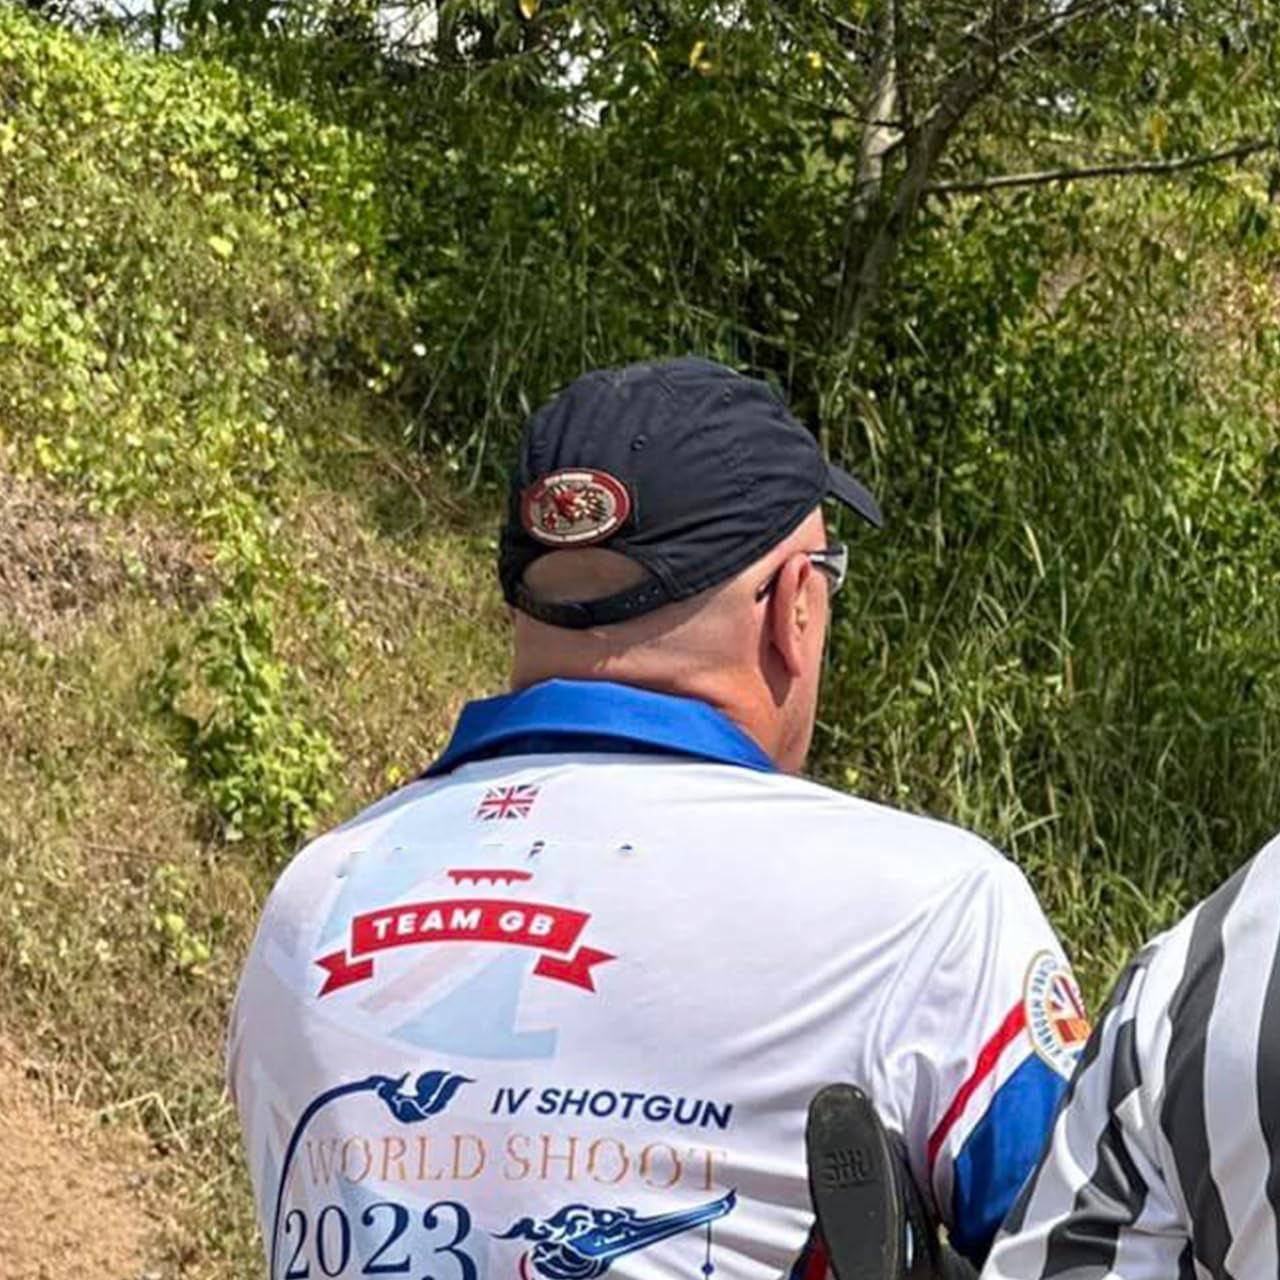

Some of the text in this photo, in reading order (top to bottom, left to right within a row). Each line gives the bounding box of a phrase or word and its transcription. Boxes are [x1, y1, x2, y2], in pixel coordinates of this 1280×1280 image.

[372, 907, 554, 939] TEAM GB
[491, 1087, 733, 1130] IV SHOTGUN
[306, 1132, 728, 1192] WORLD SHOOT
